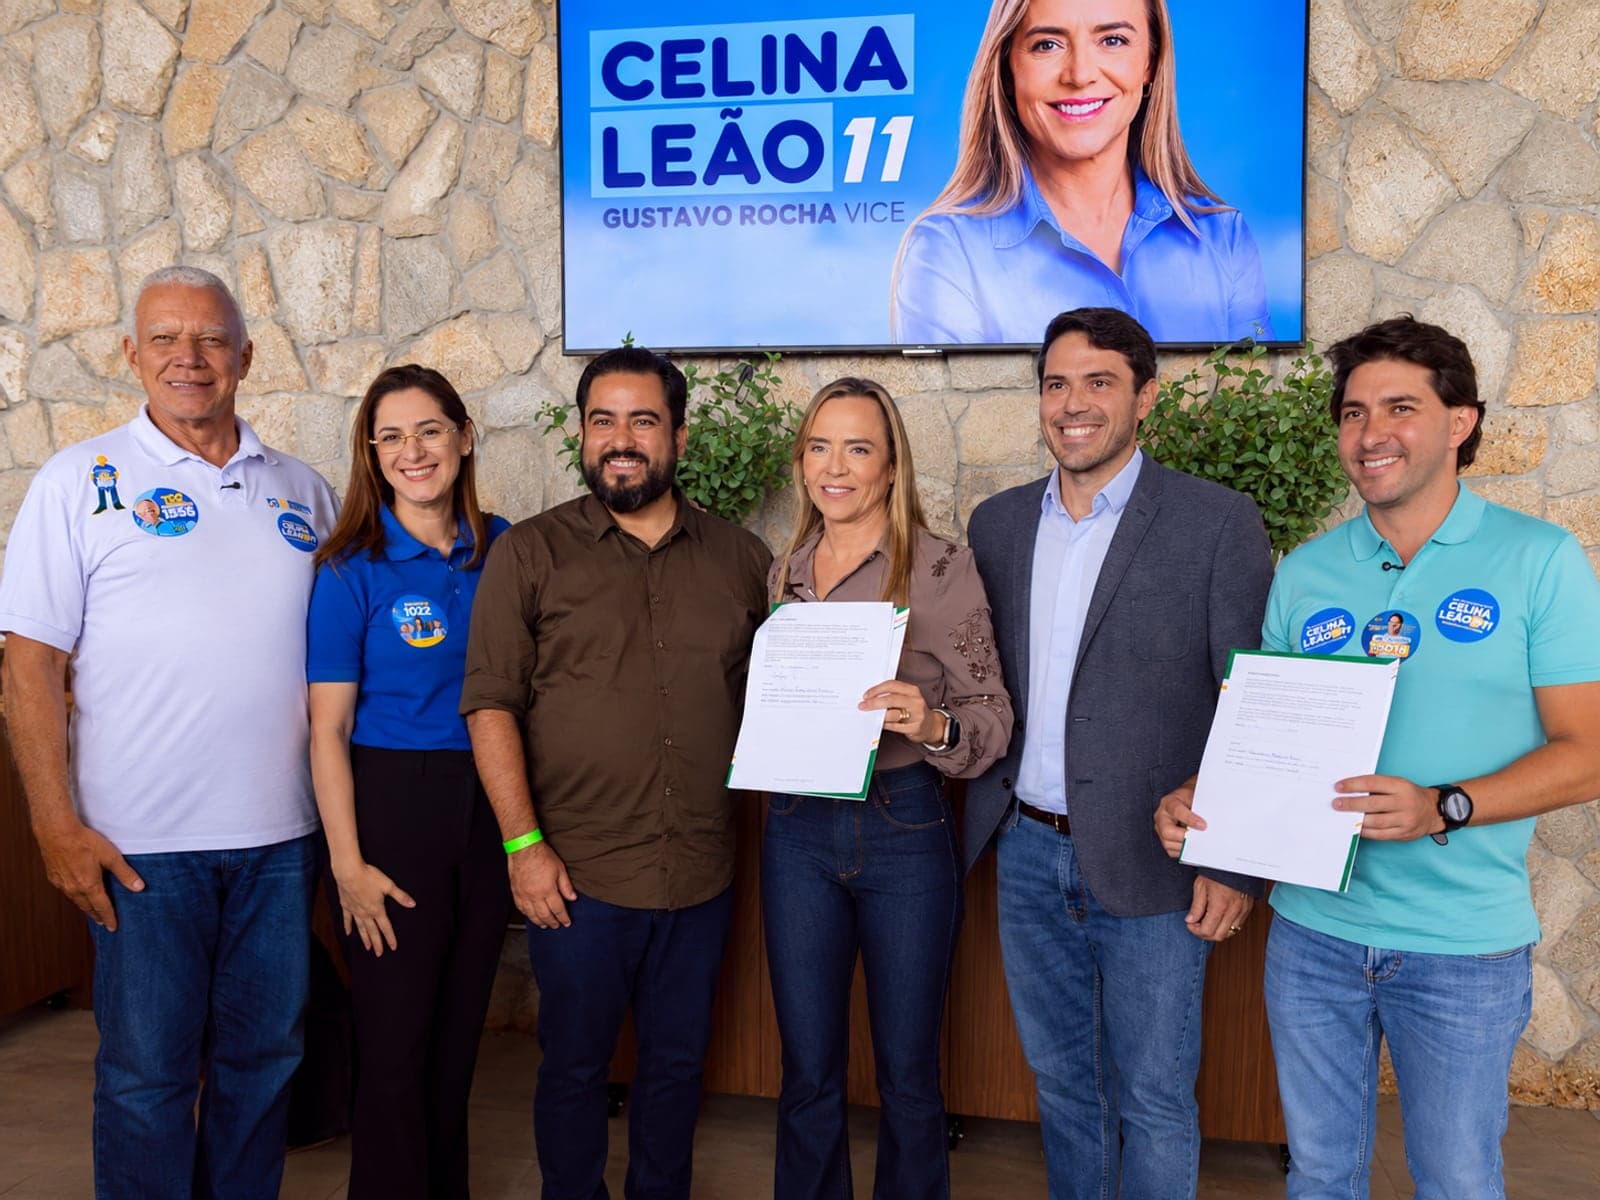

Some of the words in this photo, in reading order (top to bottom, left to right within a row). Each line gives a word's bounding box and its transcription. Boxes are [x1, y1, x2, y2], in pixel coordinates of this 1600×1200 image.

[601, 26, 908, 101] CELINA
[602, 107, 825, 188] LEÃO
[843, 115, 914, 183] 11
[602, 204, 733, 229] GUSTAVO
[740, 203, 836, 225] ROCHA
[844, 201, 905, 224] VICE
[404, 606, 432, 616] 1022
[1448, 601, 1491, 620] CELINA
[1306, 619, 1346, 637] CELINA
